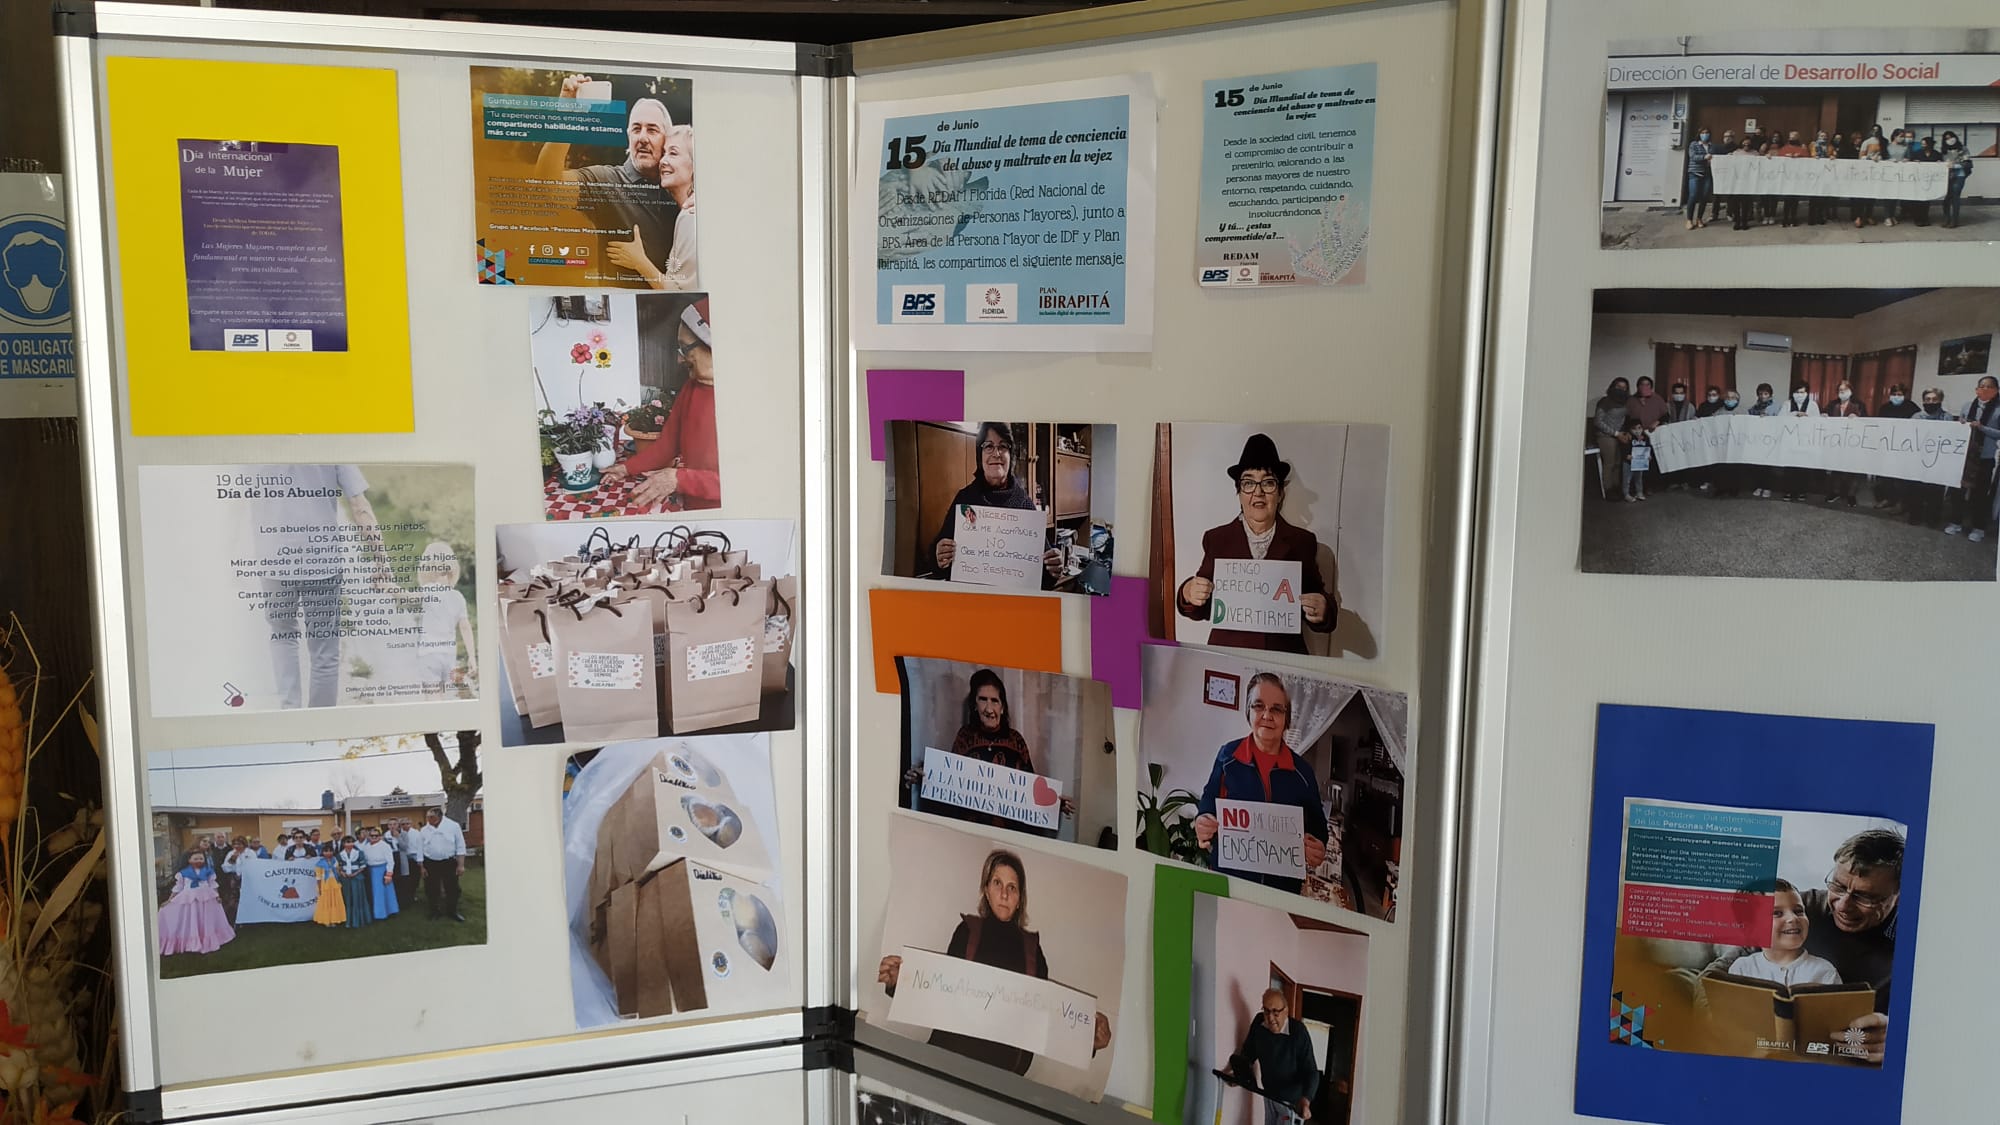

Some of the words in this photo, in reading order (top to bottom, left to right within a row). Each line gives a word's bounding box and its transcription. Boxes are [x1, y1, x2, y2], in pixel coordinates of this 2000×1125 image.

[1609, 65, 1687, 82] Dirección
[1695, 64, 1756, 80] General
[1759, 65, 1780, 80] de
[1784, 63, 1878, 80] Desarrollo
[1882, 62, 1940, 80] Social
[1215, 89, 1244, 108] 15
[1269, 93, 1306, 102] Mundial
[1344, 88, 1355, 96] de
[502, 112, 545, 120] experiencia
[1296, 112, 1316, 120] vejez
[487, 120, 542, 128] compartiendo
[545, 123, 588, 131] habilidades
[937, 121, 949, 131] de
[952, 120, 979, 131] Junio
[932, 139, 951, 153] Día
[954, 135, 1001, 151] Mundial
[1004, 135, 1017, 148] de
[1019, 136, 1046, 147] toma
[1049, 131, 1063, 144] de
[1065, 127, 1126, 142] conciencia
[1259, 134, 1294, 144] sociedad
[1318, 129, 1356, 139] tenemos
[208, 152, 272, 162] Internacional
[886, 135, 927, 170] 15
[943, 159, 959, 171] del
[961, 160, 992, 170] abuso
[994, 160, 1001, 171] y
[1003, 153, 1050, 167] maltrato
[1052, 154, 1067, 164] en
[1070, 150, 1081, 163] la
[1084, 150, 1112, 163] vejez
[223, 165, 263, 179] Mujer
[896, 193, 925, 206] Desde
[928, 190, 967, 204] REDAM
[970, 188, 1007, 201] Florida
[1010, 186, 1035, 201] (Red
[1039, 184, 1087, 199] Nacional
[1091, 183, 1105, 195] de
[878, 210, 954, 229] Organizaciones
[958, 212, 969, 224] de
[973, 211, 1020, 224] Personas
[1024, 205, 1078, 223] Mayores),
[1082, 206, 1114, 219] junto
[1118, 208, 1125, 217] a
[923, 256, 936, 268] les
[939, 256, 1007, 270] compartimos
[1010, 254, 1019, 266] el
[1022, 252, 1072, 268] siguiente
[1076, 253, 1125, 266] mensaje.
[1203, 270, 1229, 279] BPS
[902, 293, 936, 310] BPS
[1039, 291, 1110, 308] IBIRAPITÁ
[233, 334, 259, 343] BPS
[217, 474, 231, 486] 19
[235, 474, 252, 486] de
[255, 474, 293, 488] junio
[217, 488, 241, 499] Día
[244, 488, 261, 498] de
[264, 488, 284, 498] los
[286, 487, 343, 498] Abuelos
[979, 509, 1018, 521] NECESITO
[260, 526, 277, 534] Los
[280, 525, 320, 533] abuelos
[338, 523, 364, 532] crían
[394, 523, 426, 531] nietos.
[308, 535, 329, 543] LOS
[331, 534, 384, 542] ABUELAN.
[987, 538, 1005, 549] NO
[277, 545, 303, 556] ¿Qué
[306, 545, 349, 555] significa
[993, 550, 1039, 563] CONTROLES
[983, 563, 1024, 577] RESPETO
[1225, 562, 1260, 575] TENGO
[1216, 579, 1270, 595] DERECHO
[1273, 579, 1295, 603] A
[1213, 598, 1295, 627] DIVERTIRME
[304, 620, 310, 628] Y
[313, 621, 333, 630] por,
[335, 619, 363, 627] sobre
[366, 618, 391, 627] todo,
[271, 631, 302, 640] AMAR
[305, 627, 427, 638] INCONDICIONALMENTE.
[944, 756, 963, 772] NO
[977, 764, 995, 778] NO
[1009, 772, 1027, 787] NO
[958, 777, 1027, 803] VIOLENCIA
[932, 786, 994, 812] PERSONAS
[998, 802, 1049, 825] MAYORES
[1223, 808, 1250, 828] NO
[1664, 820, 1704, 829] Personas
[1706, 822, 1742, 833] Mayores
[1223, 835, 1303, 867] ENSÉÑAME
[1808, 1042, 1829, 1051] BPS
[1838, 1047, 1869, 1056] FLORIDA
